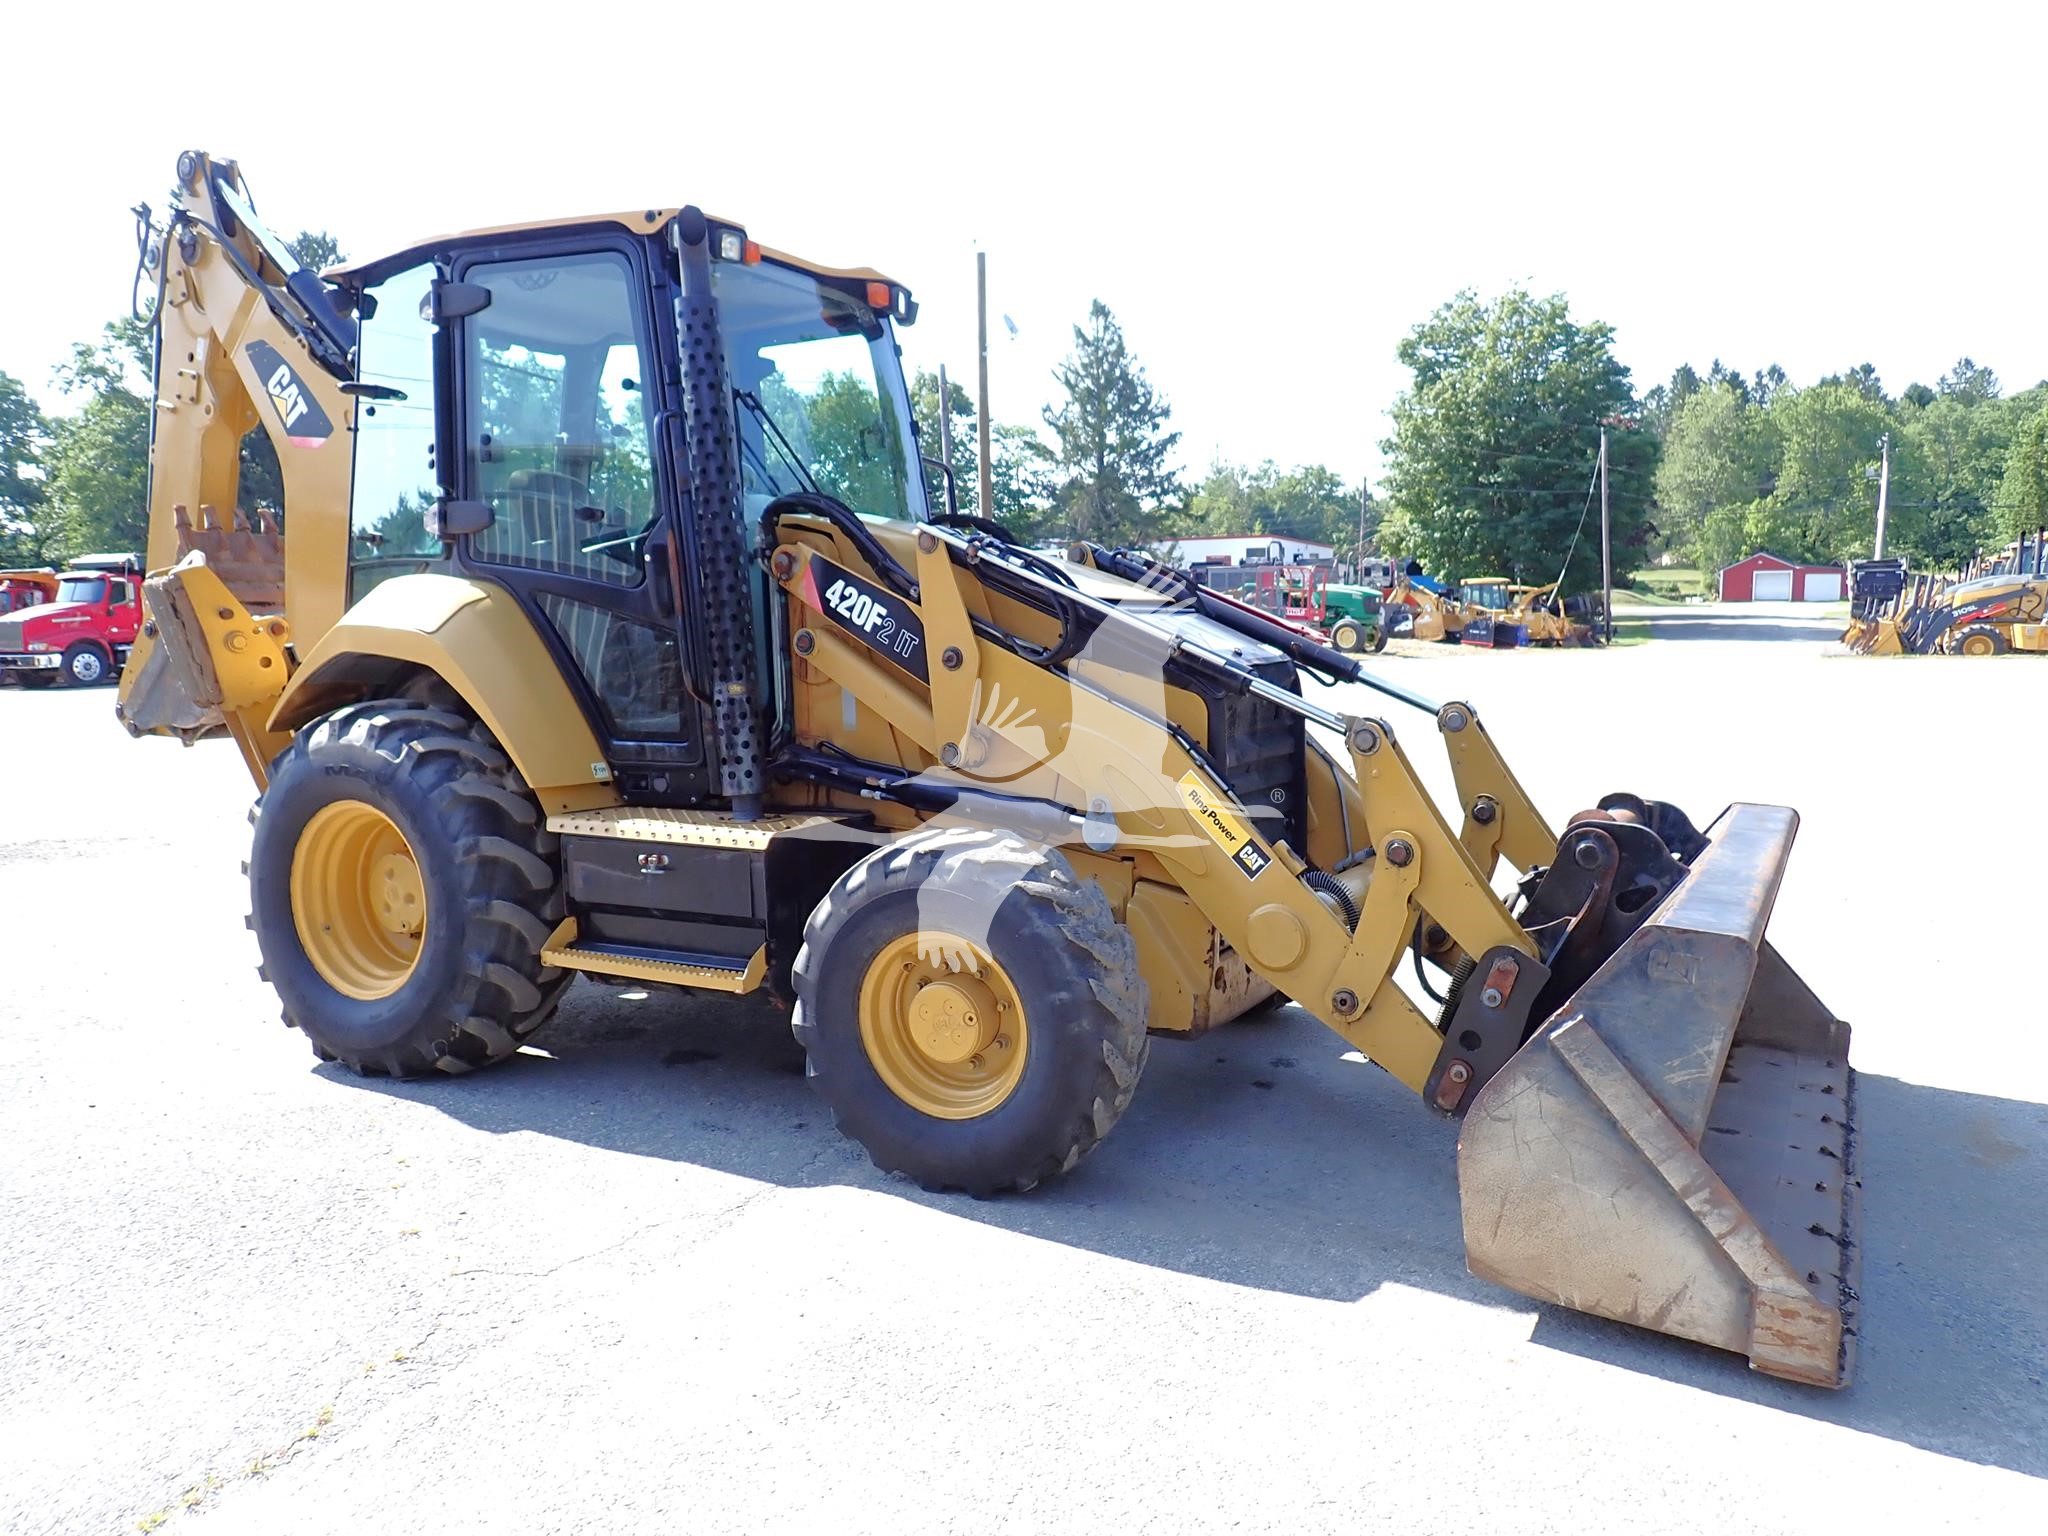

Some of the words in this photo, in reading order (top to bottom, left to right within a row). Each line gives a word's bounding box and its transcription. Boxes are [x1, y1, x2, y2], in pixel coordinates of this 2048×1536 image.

[267, 364, 309, 429] CAT
[893, 629, 919, 658] IT
[1188, 789, 1209, 814] Ring
[1207, 810, 1237, 842] Power
[1239, 845, 1266, 871] CAT
